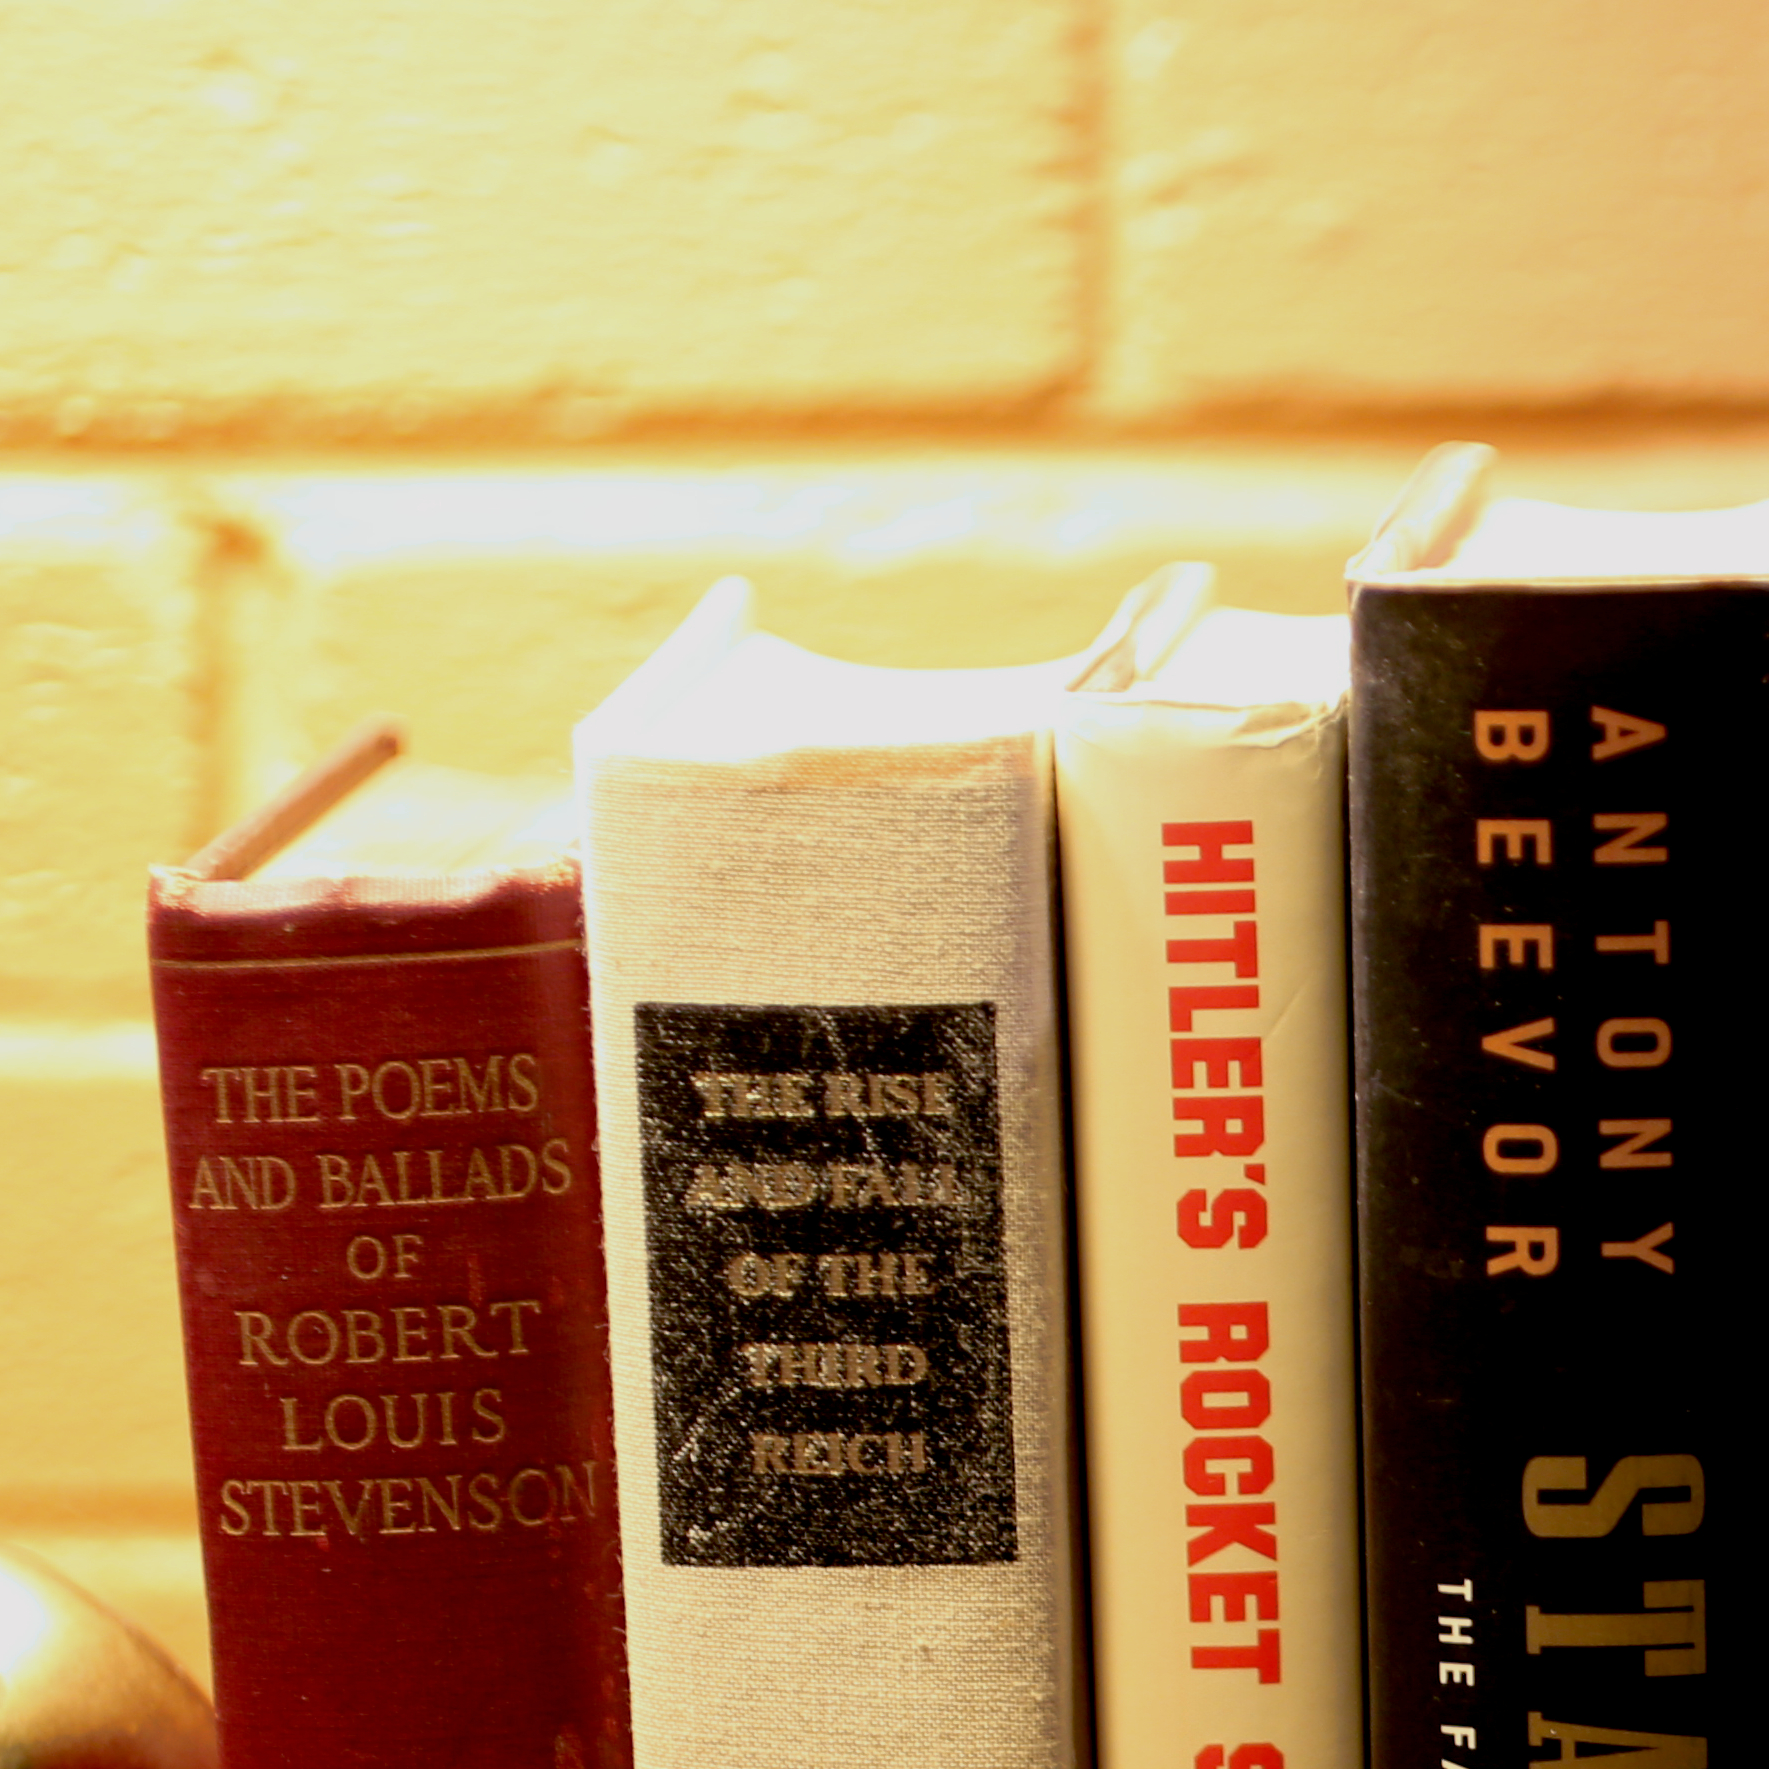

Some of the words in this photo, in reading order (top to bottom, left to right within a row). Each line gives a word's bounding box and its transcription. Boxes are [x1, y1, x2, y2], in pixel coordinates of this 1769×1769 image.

[1474, 709, 1559, 1277] BEEVOR
[1591, 705, 1675, 1275] ANTONY
[1161, 820, 1269, 1250] HITLER'S
[201, 1066, 320, 1124] THE
[334, 1053, 540, 1120] POEMS
[694, 1072, 813, 1118] THE
[824, 1071, 956, 1118] RISE
[188, 1154, 296, 1210] AND
[315, 1139, 573, 1209] BALLADS
[686, 1162, 813, 1209] AND
[831, 1162, 962, 1207] FALL
[346, 1234, 424, 1280] OF
[726, 1253, 803, 1298] OF
[819, 1253, 938, 1298] THE
[234, 1299, 541, 1367] ROBERT
[740, 1344, 930, 1387] THIRD
[280, 1388, 507, 1451] LOUIS
[751, 1432, 926, 1476] REICH
[220, 1459, 600, 1537] STEVENSON
[1177, 1301, 1282, 1685] ROCKET
[1437, 1577, 1476, 1687] THE
